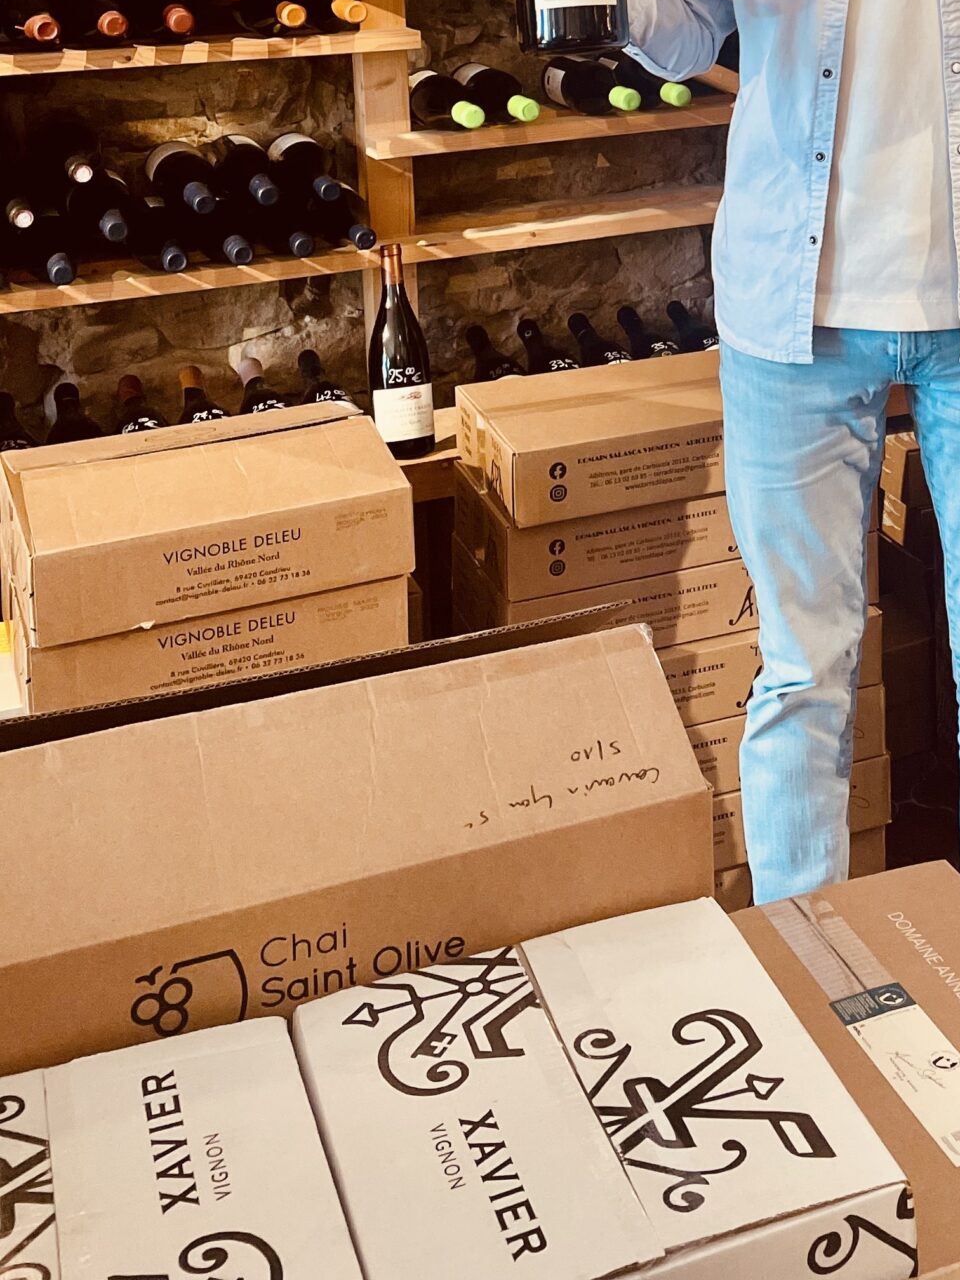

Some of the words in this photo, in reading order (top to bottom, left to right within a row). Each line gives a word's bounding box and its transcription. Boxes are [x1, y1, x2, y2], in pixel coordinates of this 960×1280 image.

[163, 538, 248, 565] VIGNOBLE
[254, 527, 302, 548] DELEU
[214, 562, 226, 572] du
[227, 558, 256, 570] Rhône
[257, 551, 280, 564] Nord
[157, 622, 242, 649] VIGNOBLE
[248, 611, 296, 633] DELEU
[208, 647, 220, 657] du
[222, 642, 251, 654] Rhône
[251, 634, 274, 648] Nord
[259, 922, 350, 968] Chai
[887, 910, 946, 968] DOMAINE
[260, 966, 358, 1009] Saint
[372, 934, 466, 978] Olive
[141, 1068, 202, 1216] XAVIER
[203, 1131, 232, 1202] VIGNON
[428, 1122, 466, 1192] VIGNON
[457, 1108, 548, 1262] XAVIER
